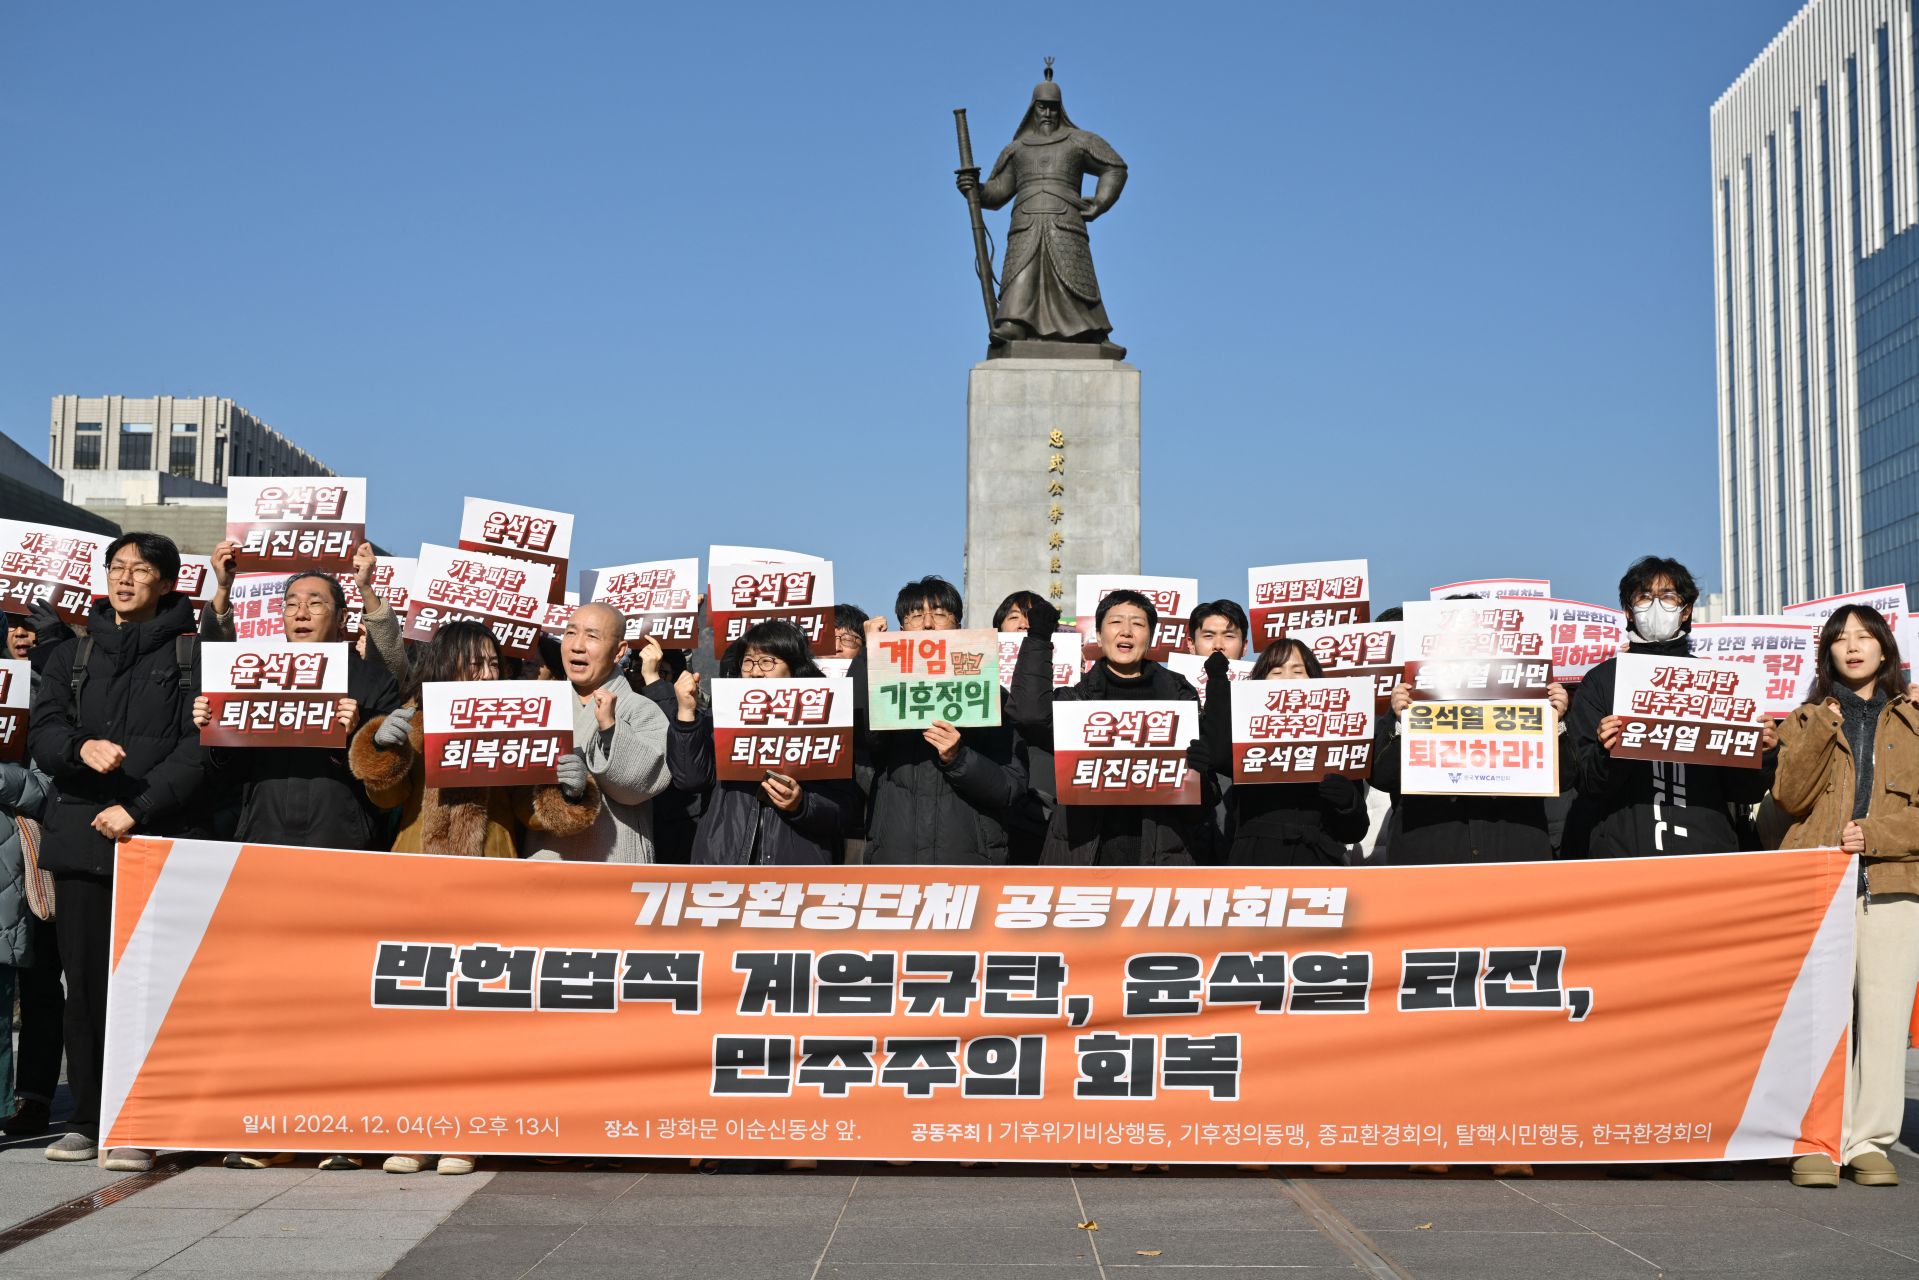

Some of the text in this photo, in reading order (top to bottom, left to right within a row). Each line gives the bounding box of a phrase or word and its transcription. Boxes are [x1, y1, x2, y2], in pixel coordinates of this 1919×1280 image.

[255, 487, 346, 519] 윤석열
[242, 530, 353, 558] 퇴진하라
[484, 512, 556, 551] 윤석열
[21, 533, 93, 562] 기후 파탄
[2, 552, 92, 584] 민주주의 파
[448, 560, 483, 582] 기후
[486, 566, 526, 592] 파탄
[607, 569, 674, 593] 기후 파탄
[250, 581, 287, 598] 심판한
[428, 579, 498, 611] 민주주의
[497, 593, 538, 619] 파탄
[652, 588, 690, 610] 파탄
[732, 572, 814, 607] 윤석열
[1257, 576, 1363, 604] 반헌법적 계엄
[649, 616, 694, 639] 파면
[726, 614, 824, 641] 퇴라
[1481, 609, 1524, 631] 파탄
[1563, 609, 1617, 625] 심판한다
[492, 622, 537, 650] 파면
[1314, 631, 1395, 665] 윤석열
[1421, 634, 1499, 657] 민주의
[1500, 633, 1543, 656] 파탄
[1583, 624, 1622, 643] 즉각
[1718, 636, 1746, 651] 안전
[1751, 636, 1806, 650] 위협하는
[879, 638, 946, 675] 계엄
[1763, 655, 1804, 676] 즉각
[231, 653, 327, 691] 윤석열
[1415, 664, 1489, 689] 윤열
[1497, 663, 1549, 688] 파면
[1650, 667, 1694, 690] 기후
[1694, 669, 1739, 695] 파탄
[450, 697, 551, 729] 민주주의
[739, 688, 833, 725] 윤석열
[880, 680, 990, 722] 기후정의
[1266, 688, 1350, 713] 기후 파탄
[1632, 690, 1756, 722] 민주주의 파탄
[219, 700, 336, 731] 퇴진하라
[1084, 711, 1179, 747] 윤석열
[1250, 713, 1367, 738] 민주주의 파탄
[1409, 706, 1543, 731] 윤석열 정권
[440, 737, 560, 770] 회복하라
[731, 734, 841, 766] 퇴진하라
[1409, 739, 1543, 769] 퇴진하라!
[1621, 722, 1759, 757] 윤석열 파면
[1242, 744, 1369, 773] 윤석열 파면
[1072, 758, 1187, 790] 퇴진하라
[631, 880, 1348, 930] 기후환경단체 공동기자회견
[371, 940, 1593, 1027] 반헌법적 계엄규탄, 윤석열 퇴진,
[709, 1031, 1241, 1101] 민주주의 회복
[243, 1115, 559, 1138] 일시 2024. 12. 04(수) 오후 13시
[604, 1118, 862, 1141] 장소 광화문 이순신동상 앞.
[911, 1121, 1713, 1149] 공동주최 기후위기비상행동, 기후정의동맹, 종교환경회의, 탈핵시민행동, 한국환경회의
